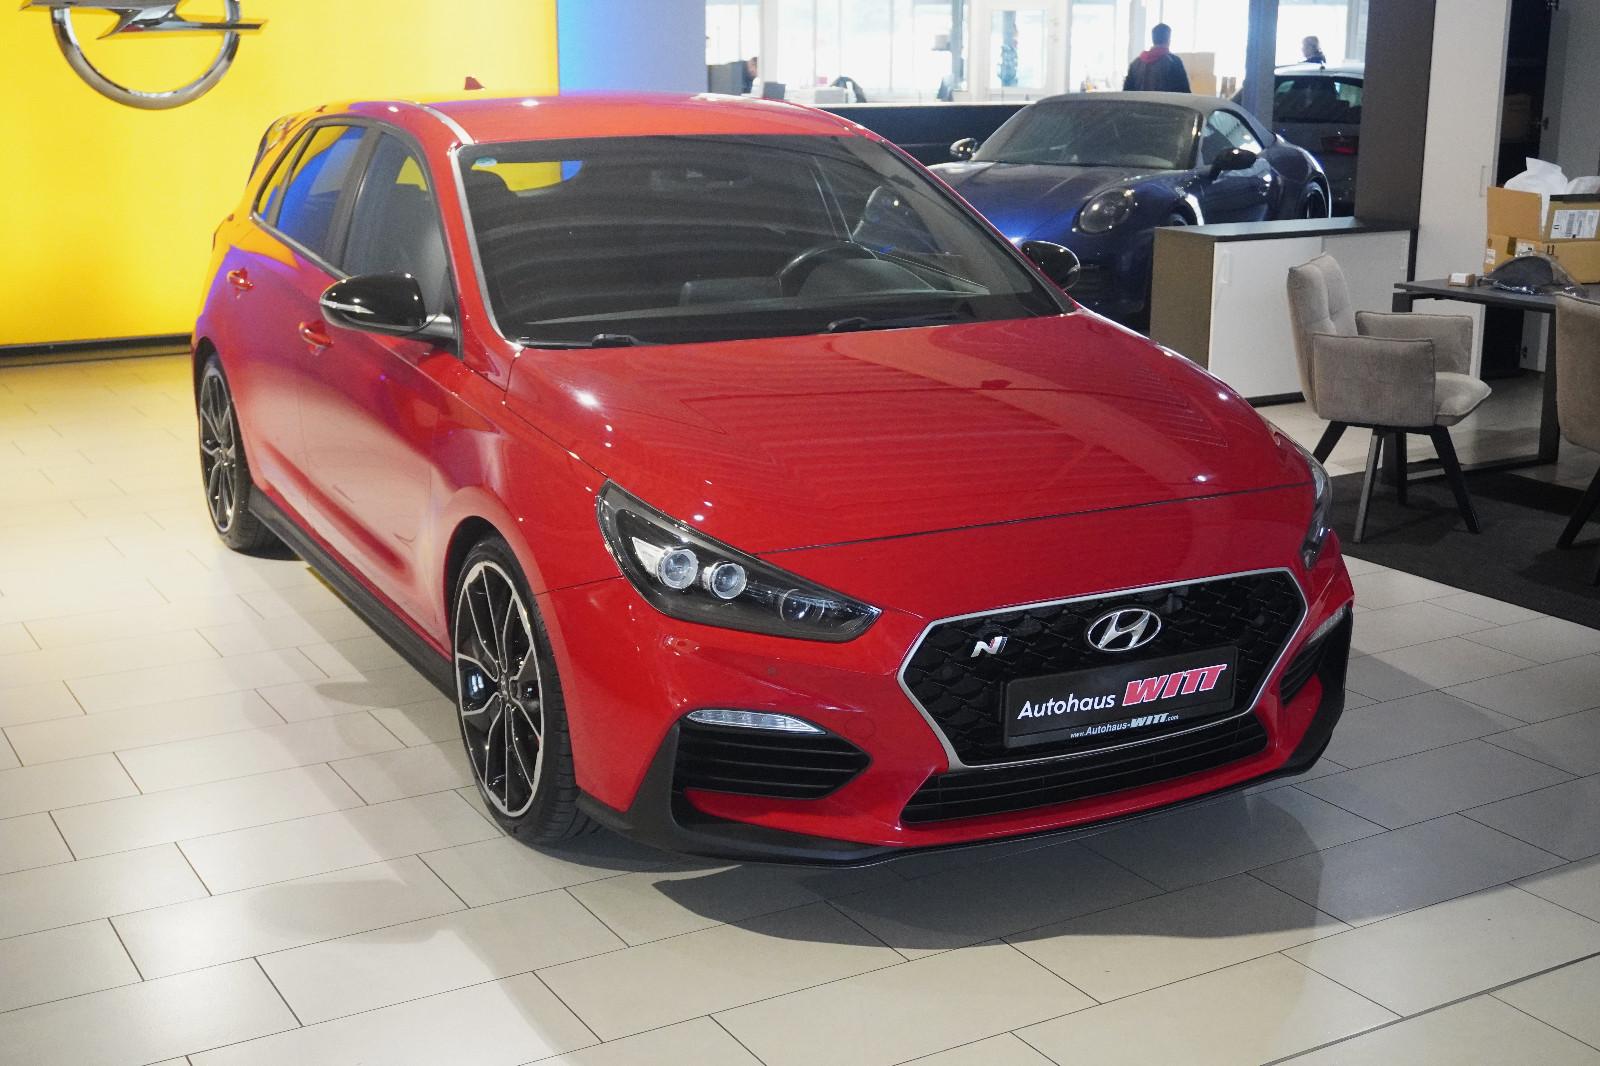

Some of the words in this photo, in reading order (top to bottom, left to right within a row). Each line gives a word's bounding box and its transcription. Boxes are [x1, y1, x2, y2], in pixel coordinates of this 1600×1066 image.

[971, 636, 1007, 658] N
[1017, 693, 1116, 721] Autohaus
[1122, 664, 1228, 707] WITT
[1070, 712, 1179, 739] www.Autohaus-WITT.com
